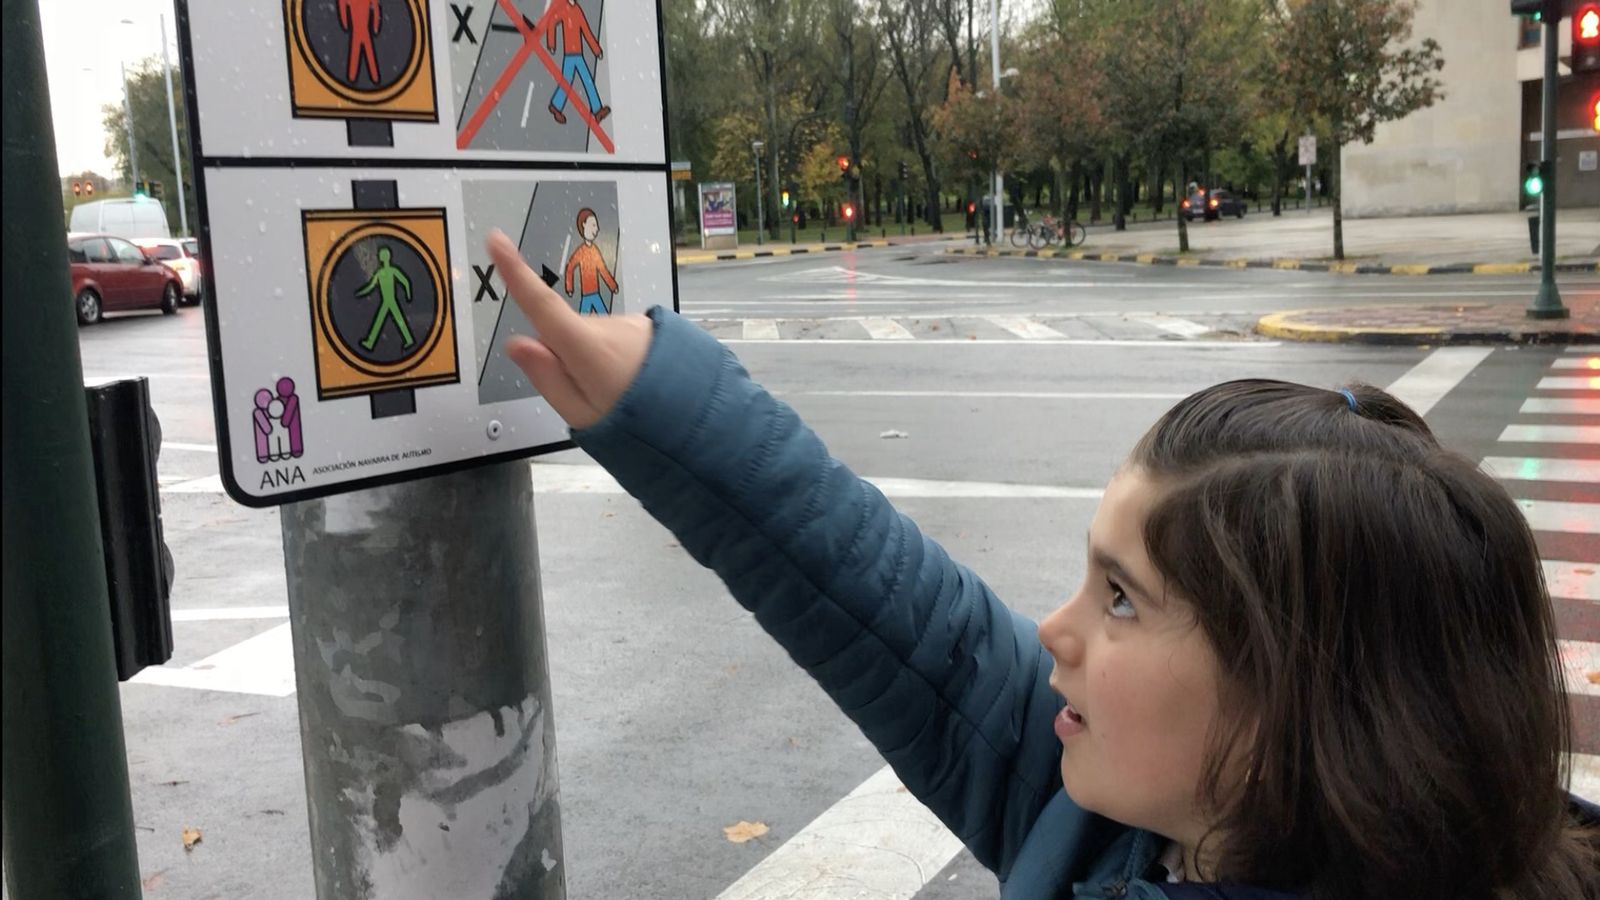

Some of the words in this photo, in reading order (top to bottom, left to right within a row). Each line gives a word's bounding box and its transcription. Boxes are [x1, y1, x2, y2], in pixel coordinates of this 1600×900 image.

[312, 460, 356, 475] ASOCIACIÓN
[357, 455, 390, 467] NAVARRA
[391, 453, 400, 461] DE
[401, 448, 432, 459] AUTISMO
[260, 465, 306, 490] ANA
